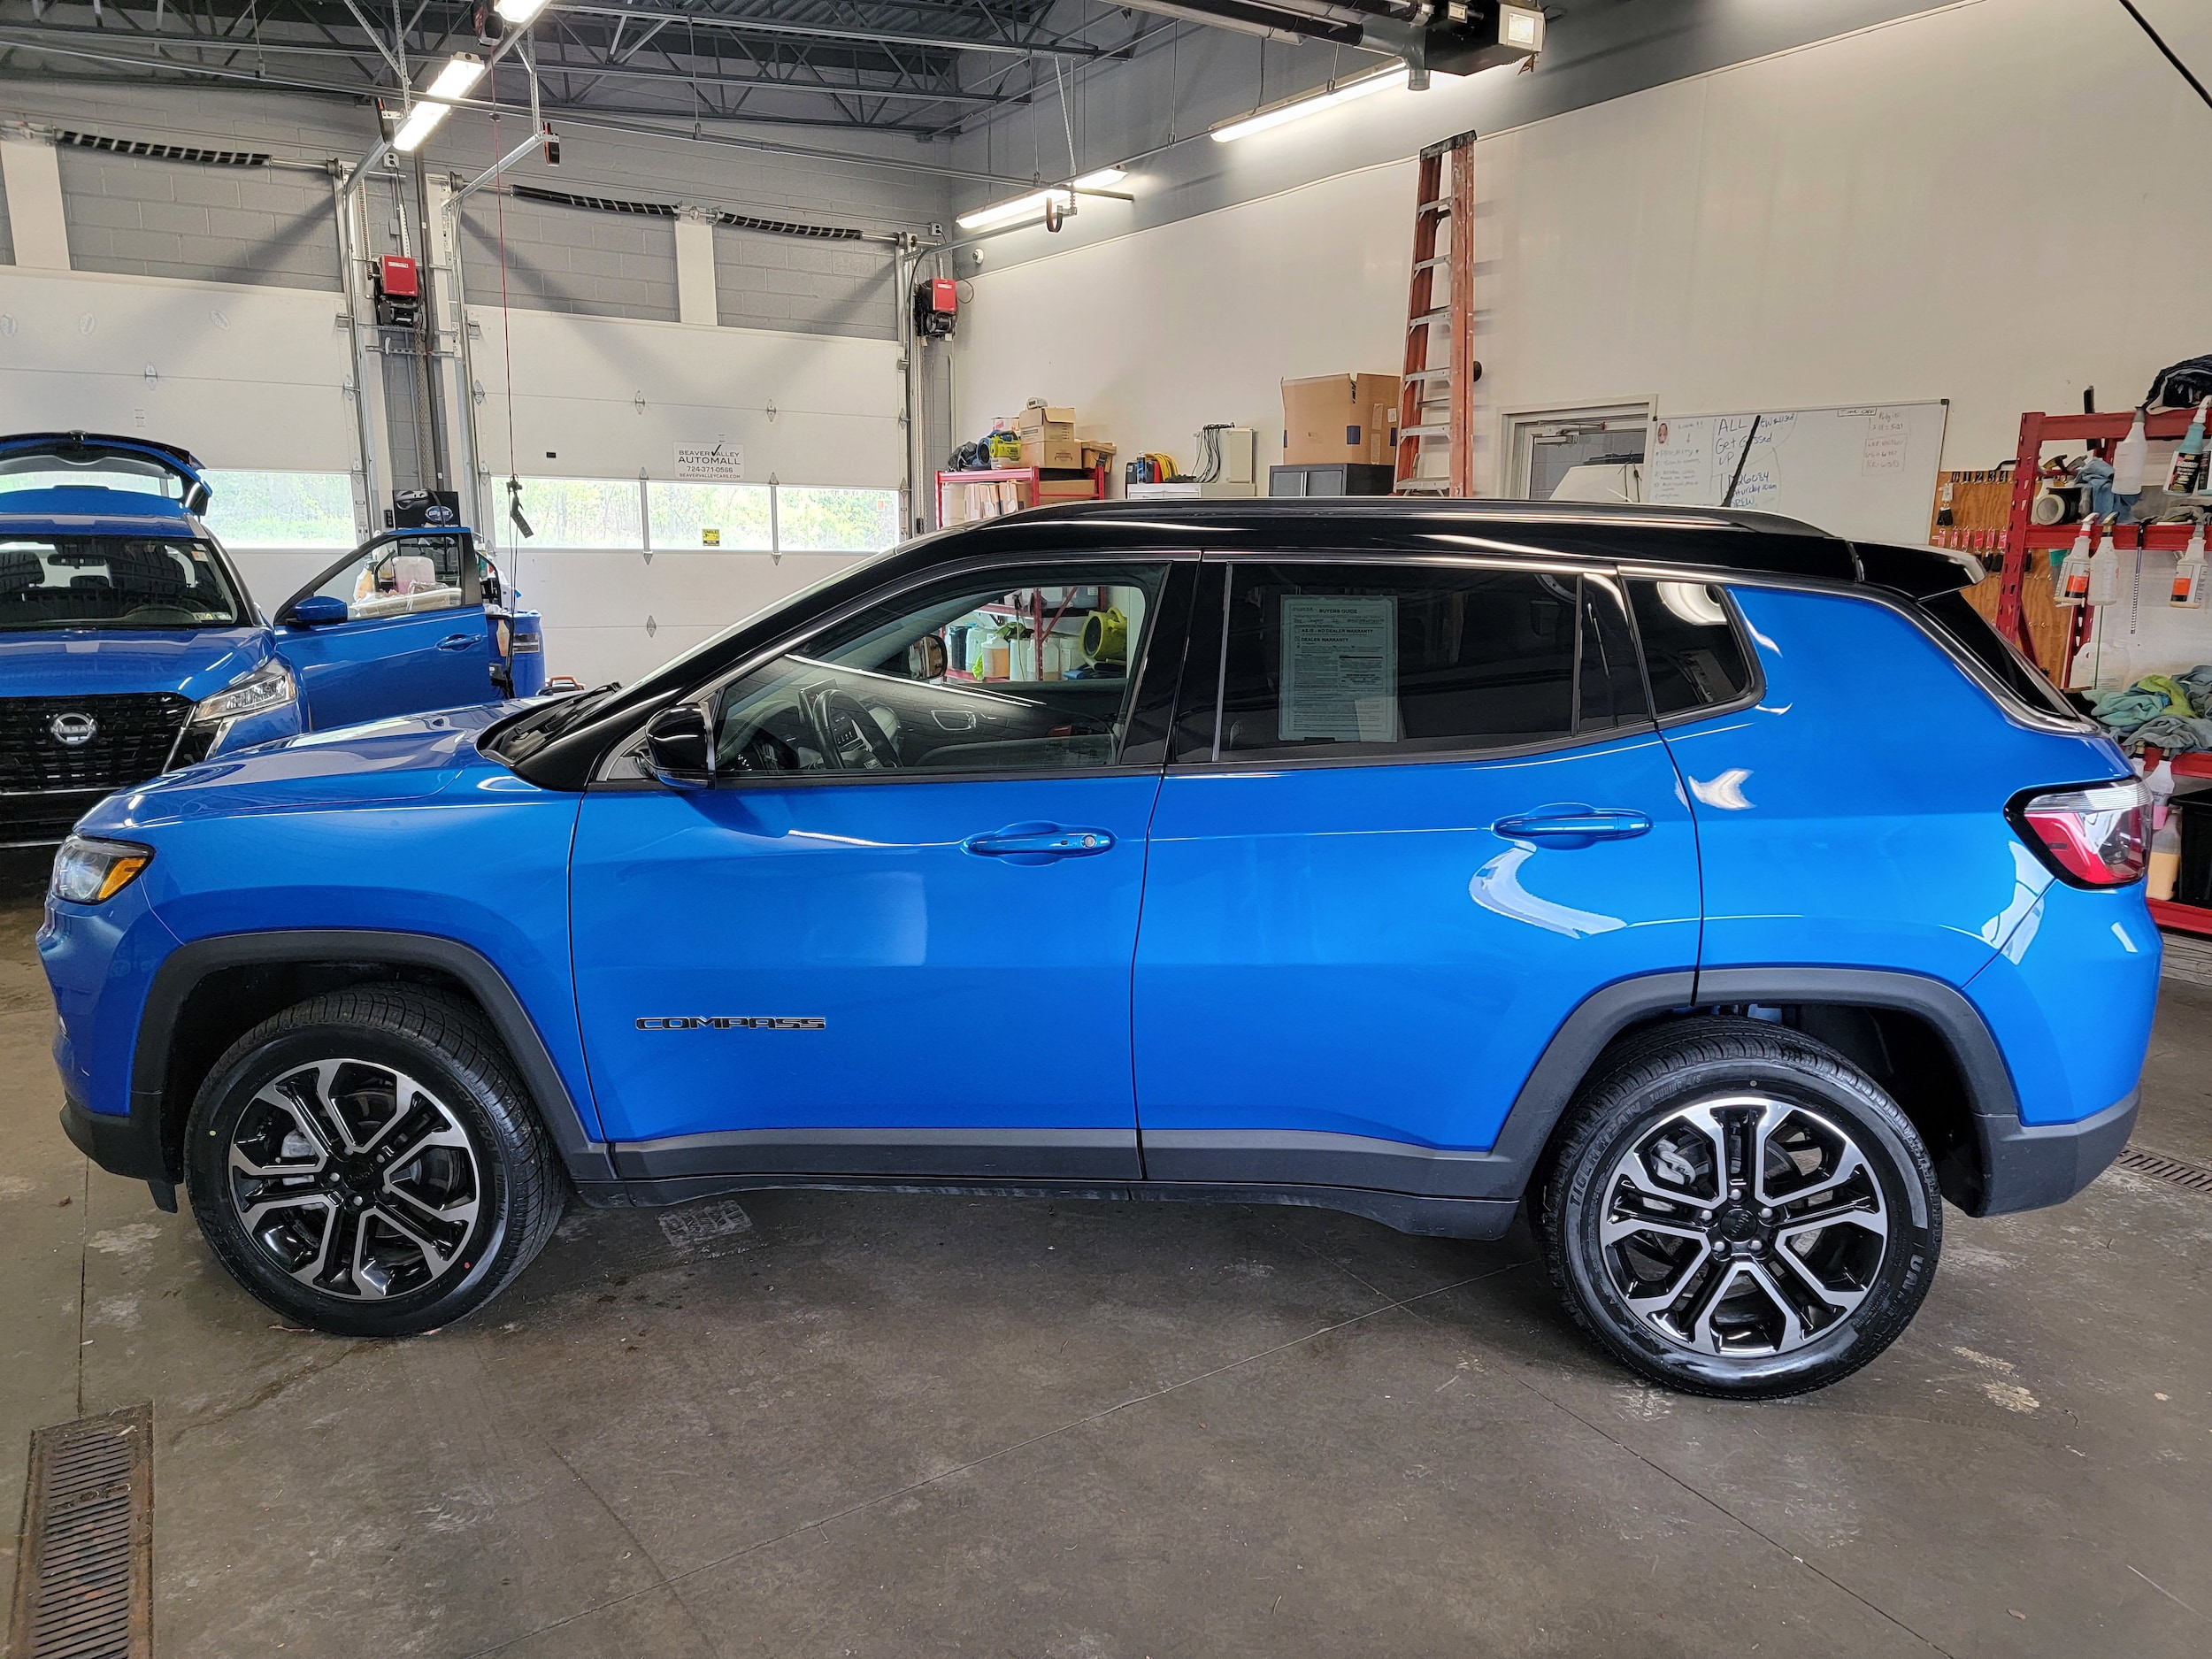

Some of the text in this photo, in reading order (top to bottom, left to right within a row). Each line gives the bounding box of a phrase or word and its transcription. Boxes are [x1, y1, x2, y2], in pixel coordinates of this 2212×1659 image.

[1718, 419, 1747, 435] ALL
[1739, 433, 1772, 449] Gssed
[678, 456, 741, 465] AUTOMALL
[1976, 471, 1984, 482] 2
[1988, 471, 1996, 482] 3
[2001, 471, 2008, 482] 4
[635, 1016, 826, 1030] COMPASS
